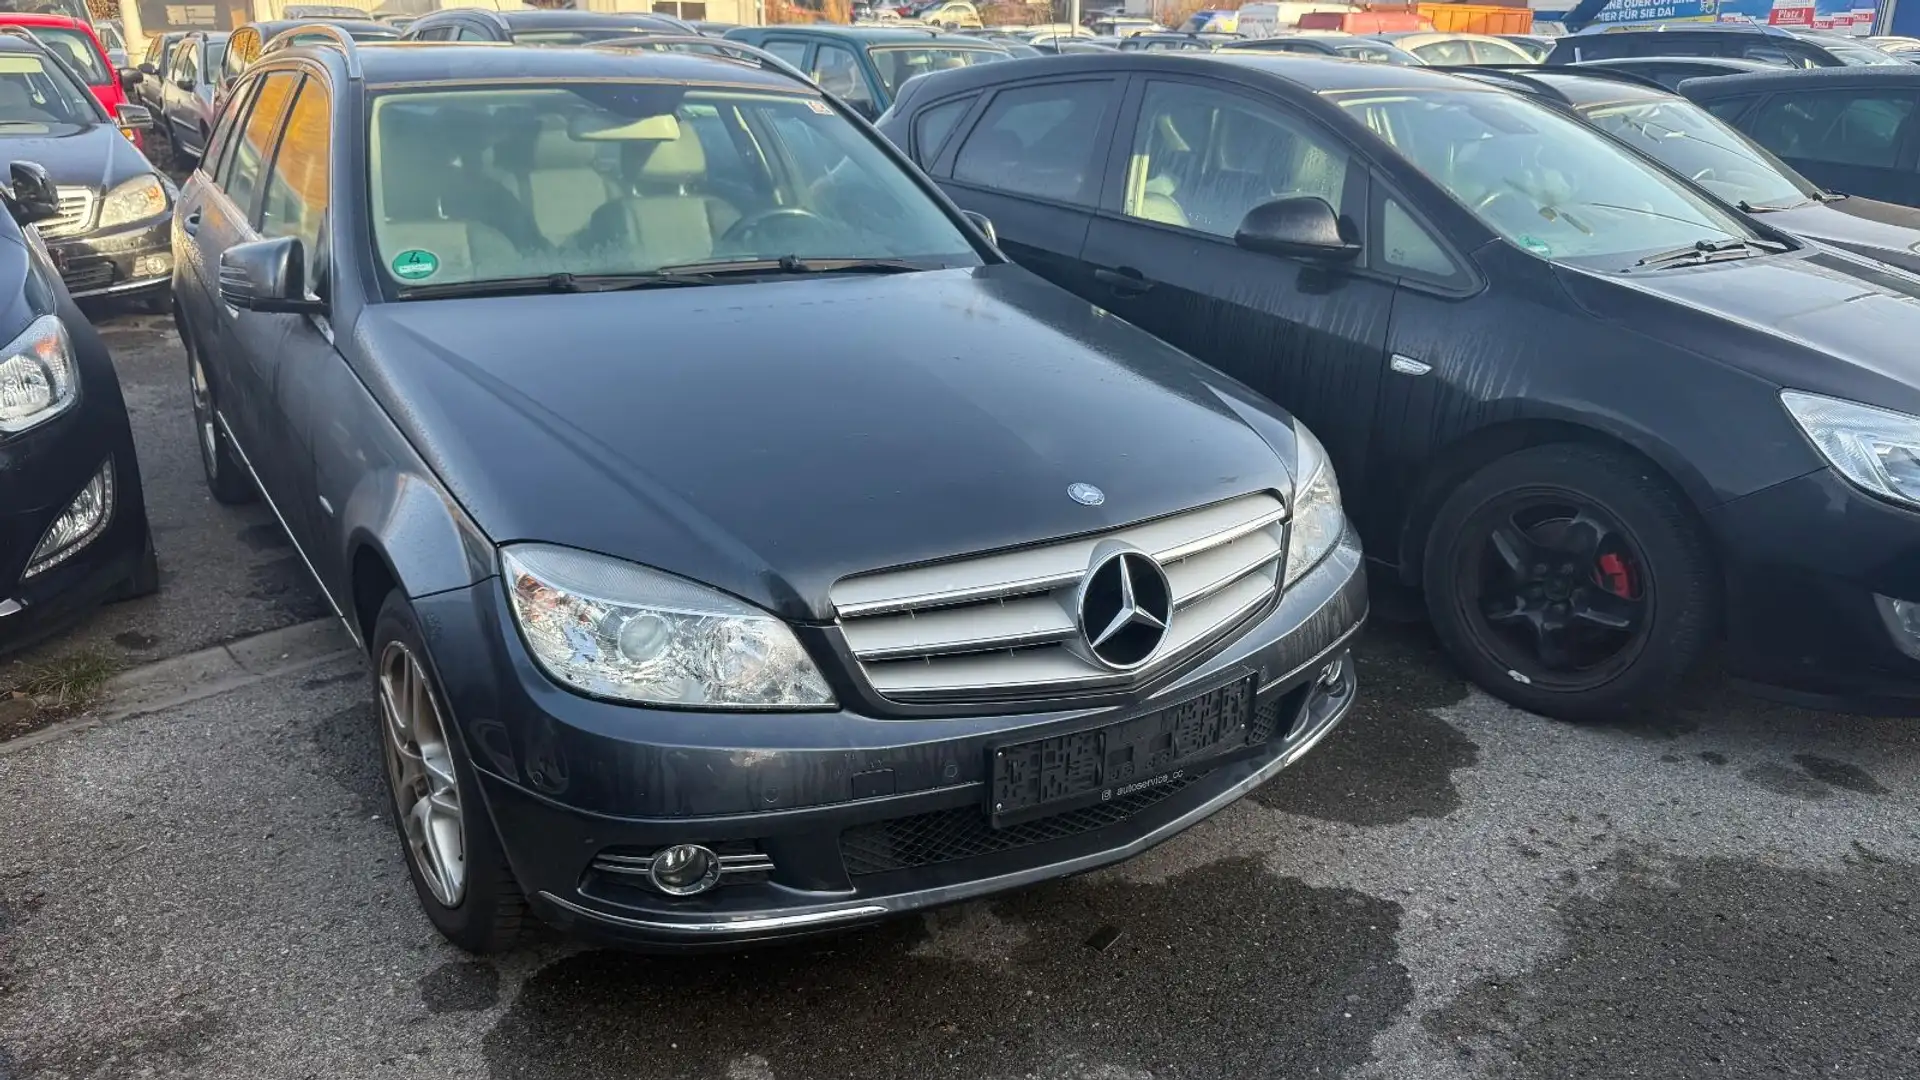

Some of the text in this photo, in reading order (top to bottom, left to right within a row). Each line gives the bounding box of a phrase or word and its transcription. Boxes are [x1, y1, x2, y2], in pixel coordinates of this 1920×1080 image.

[1618, 9, 1638, 21] FÜR
[1640, 8, 1655, 18] SIE
[1657, 6, 1675, 17] DA!
[409, 251, 420, 264] 4
